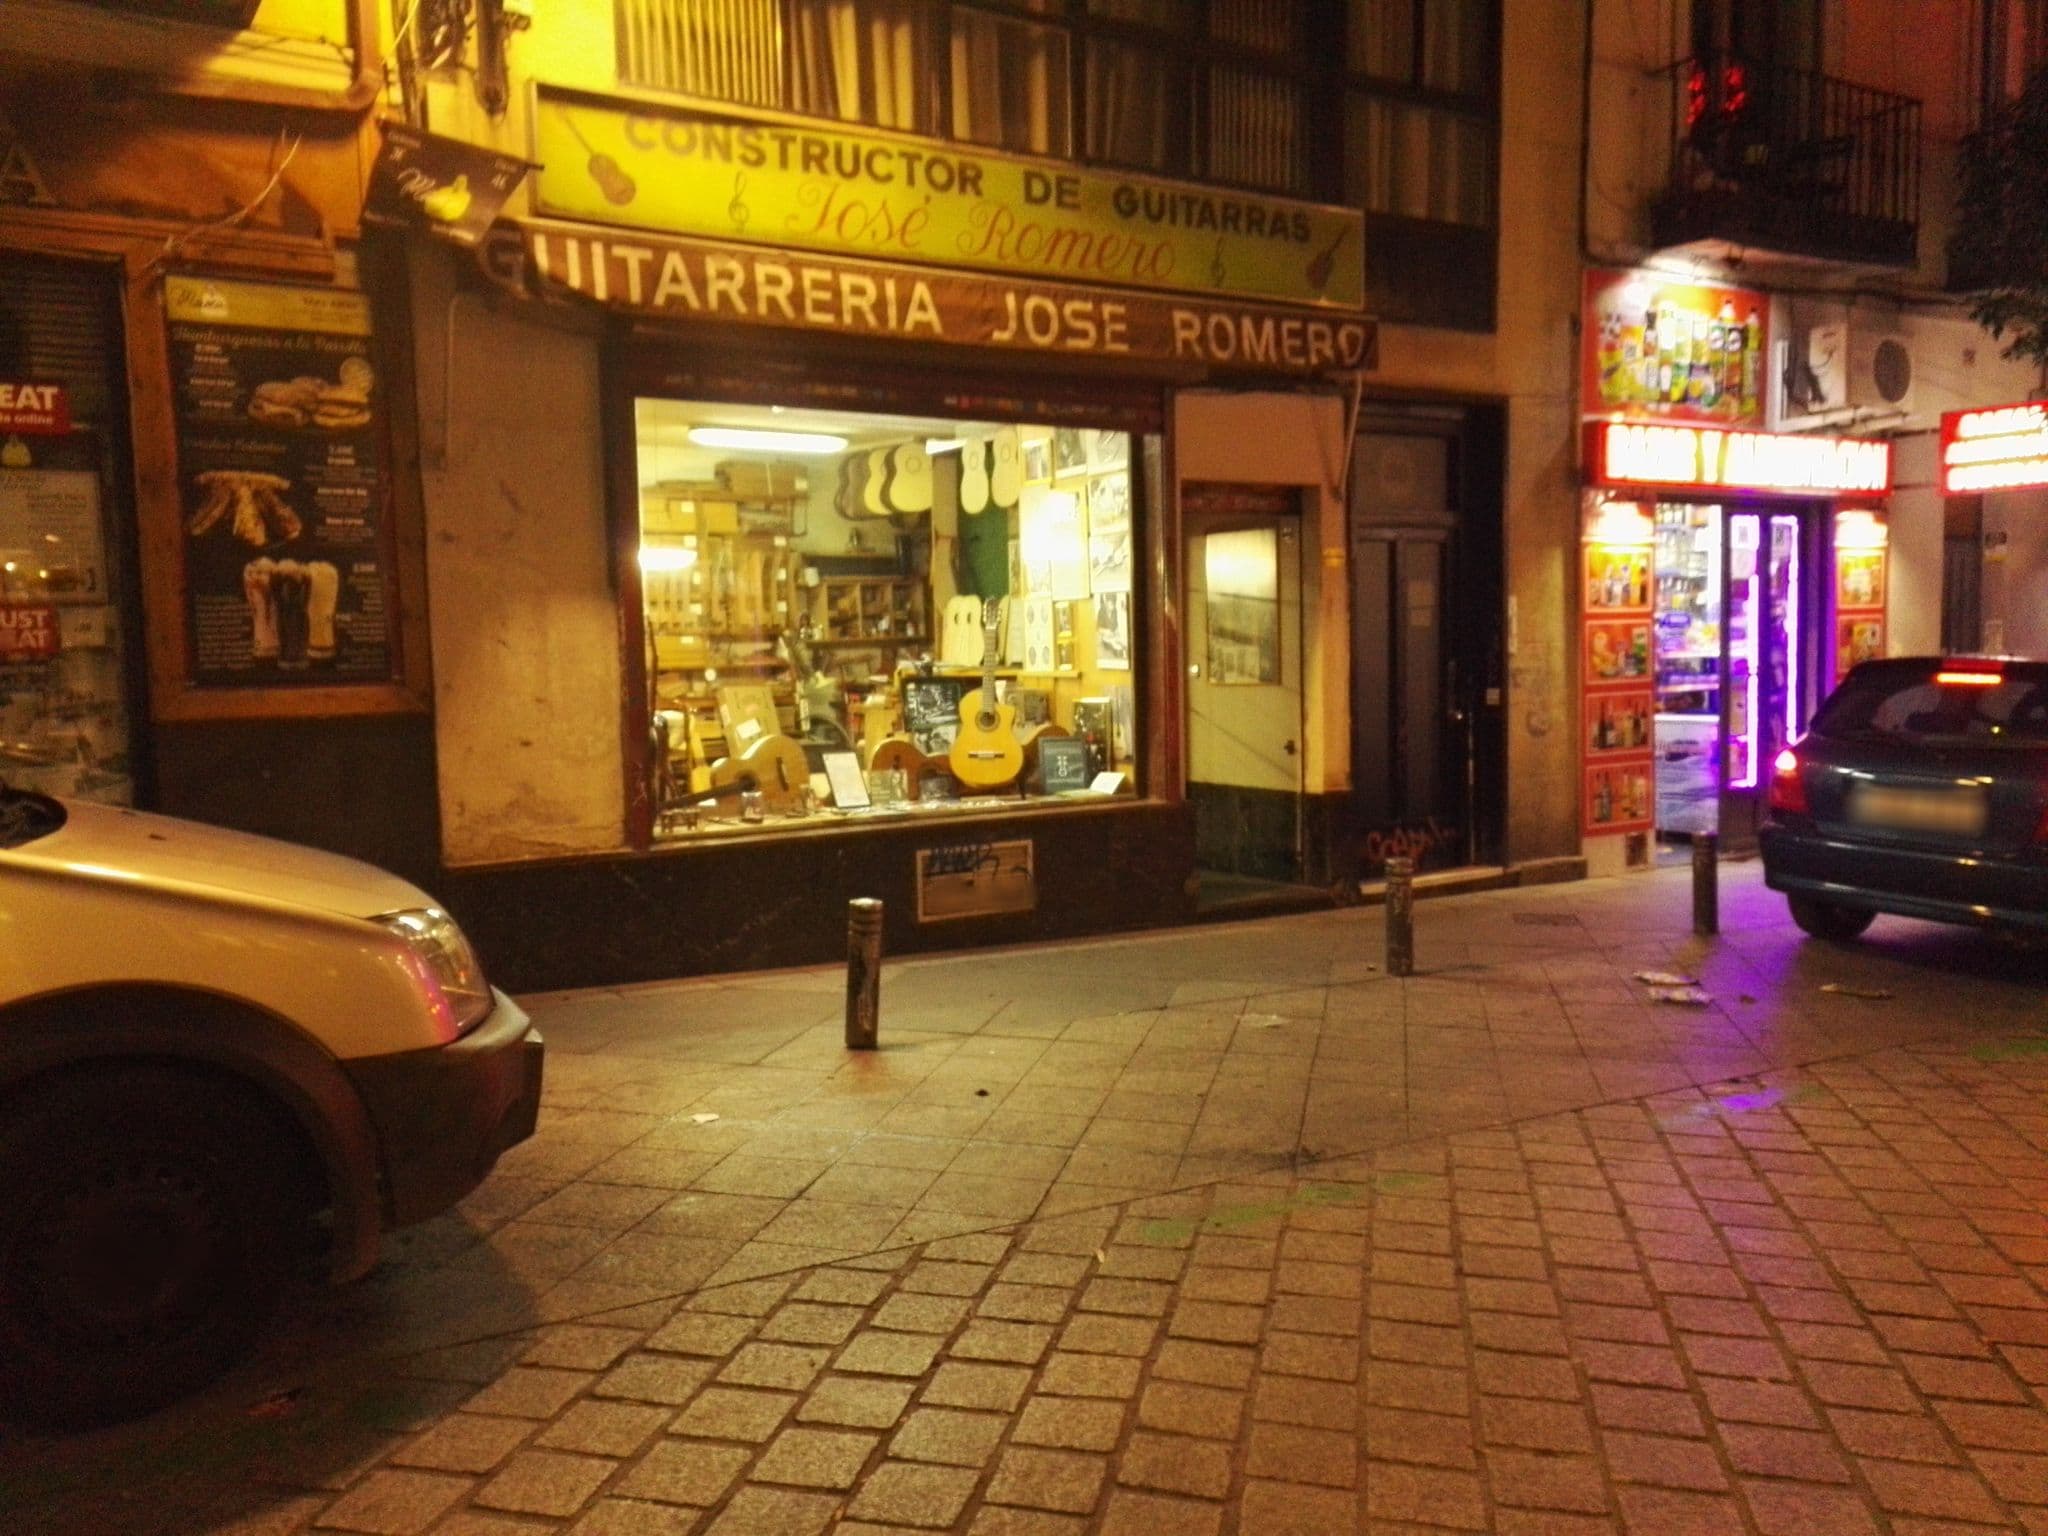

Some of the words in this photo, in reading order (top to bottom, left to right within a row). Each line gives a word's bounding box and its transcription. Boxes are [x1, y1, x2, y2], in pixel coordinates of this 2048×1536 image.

[624, 113, 983, 197] CONSTRUCTOR
[1023, 169, 1082, 210] DE
[1112, 183, 1310, 244] GUITARRAS
[956, 203, 1175, 280] Romero
[992, 291, 1130, 351] JOSE
[1171, 309, 1364, 365] ROMERO
[0, 384, 59, 411] EAT
[1701, 431, 1722, 482] Y
